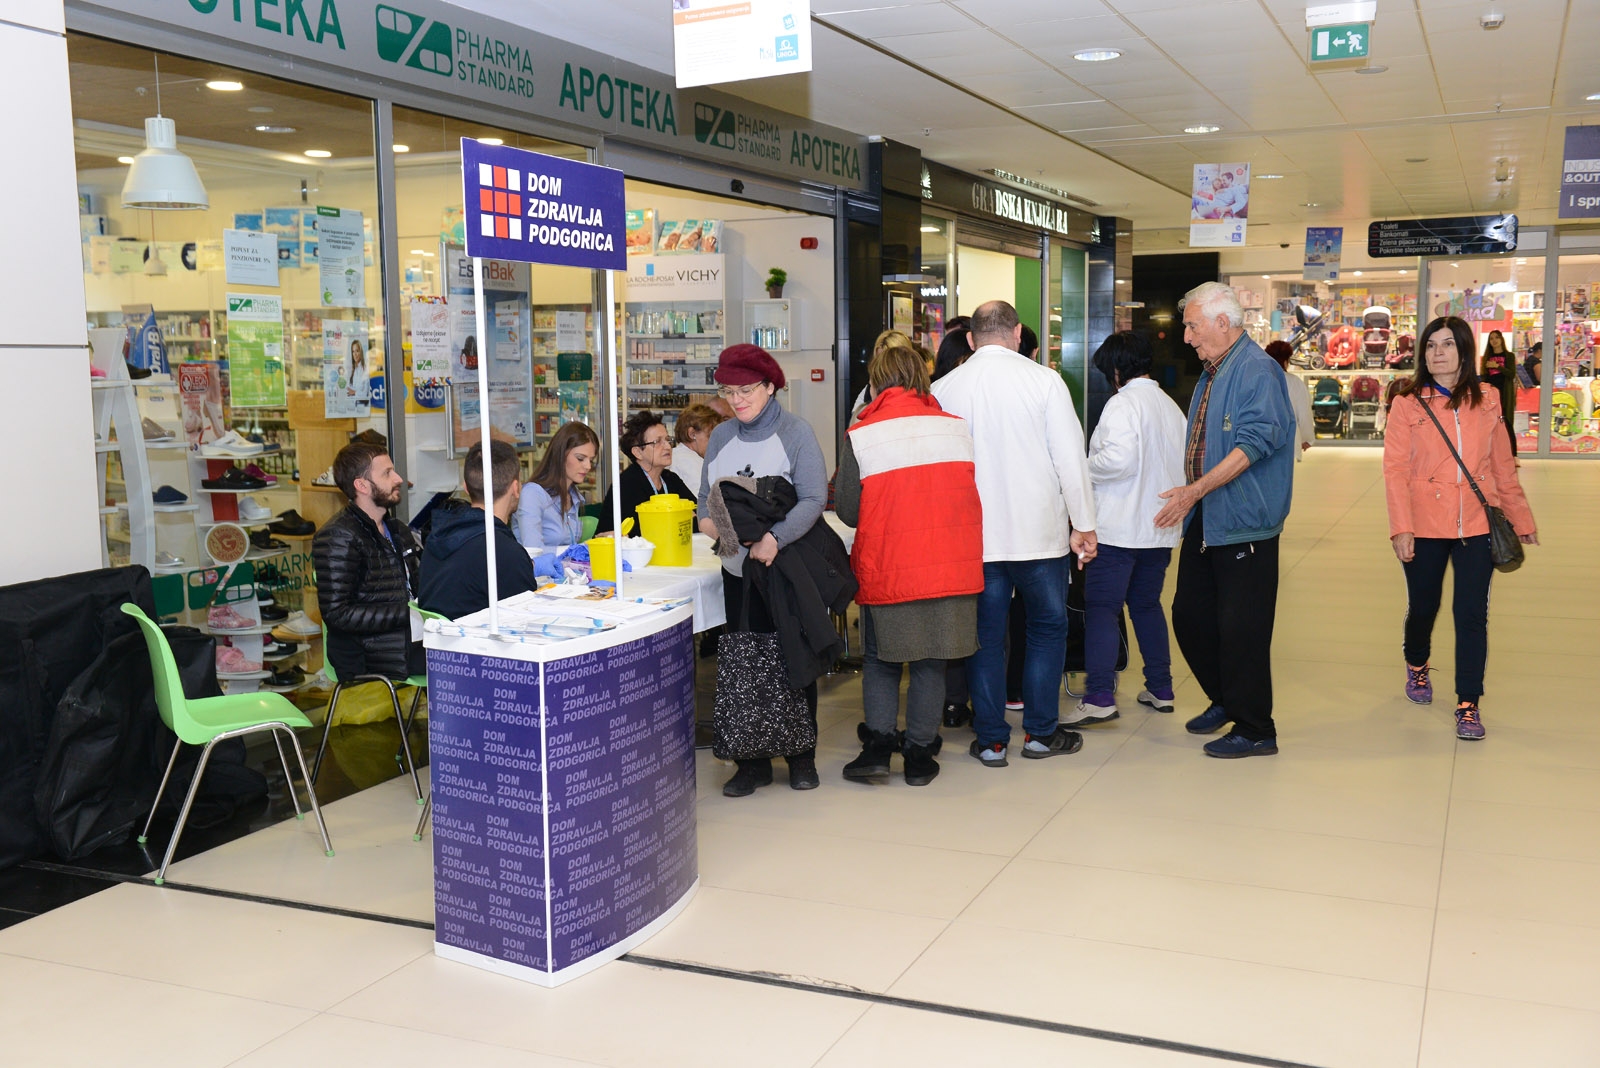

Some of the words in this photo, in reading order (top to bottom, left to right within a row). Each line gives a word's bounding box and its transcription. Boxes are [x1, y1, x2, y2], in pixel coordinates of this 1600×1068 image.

[456, 28, 534, 76] PHARMA
[458, 60, 534, 98] STANDARD
[559, 62, 678, 136] APOTEKA
[738, 114, 781, 144] PHARMA
[738, 138, 782, 162] STANDARD
[790, 130, 861, 181] APOTEKA
[528, 172, 562, 196] DOM
[528, 198, 603, 227] ZDRAVLJA
[971, 182, 1022, 223] GRADSKA
[1024, 198, 1068, 235] KNJIŽARA
[528, 224, 614, 252] PODGORICA
[1404, 246, 1430, 254] stepenice
[458, 258, 516, 281] EsnBak
[676, 269, 720, 282] VICHY
[148, 331, 161, 374] Oral-B
[607, 639, 645, 658] ZDRAVLJA
[608, 648, 650, 669] PODGORICA
[481, 656, 533, 672] ZDRAVLJA
[546, 652, 597, 672] ZDRAVLJA
[482, 670, 540, 686] PODGORICA
[546, 663, 604, 685] PODGORICA
[619, 669, 636, 683] DOM
[619, 674, 654, 695] ZDRAVLJA
[436, 679, 456, 691] DOM
[494, 688, 516, 700] DOM
[563, 685, 585, 698] DOM
[620, 683, 658, 707] PODGORICA
[436, 691, 484, 707] ZDRAVLJA
[563, 690, 610, 711] ZDRAVLJA
[436, 704, 492, 721] PODGORICA
[563, 700, 616, 724] PODGORICA
[609, 714, 627, 729] DOM
[483, 730, 506, 742] DOM
[548, 732, 573, 747] DOM
[609, 718, 646, 740] ZDRAVLJA
[483, 742, 536, 759] ZDRAVLJA
[548, 736, 600, 759] ZDRAVLJA
[610, 728, 651, 752] PODGORICA
[484, 754, 543, 772] PODGORICA
[549, 746, 606, 771] PODGORICA
[621, 750, 637, 764] DOM
[621, 752, 656, 776] ZDRAVLJA
[439, 762, 459, 774] DOM
[565, 769, 587, 785] DOM
[622, 762, 660, 788] PODGORICA
[439, 774, 487, 791] ZDRAVLJA
[497, 773, 520, 786] DOM
[565, 772, 612, 796] ZDRAVLJA
[440, 786, 495, 805] PODGORICA
[566, 782, 618, 808] PODGORICA
[612, 796, 629, 812] DOM
[612, 798, 648, 823] ZDRAVLJA
[486, 815, 509, 828] DOM
[551, 818, 576, 833] DOM
[612, 808, 653, 835] PODGORICA
[486, 827, 539, 846] ZDRAVLJA
[551, 820, 602, 845] ZDRAVLJA
[623, 830, 640, 846] DOM
[442, 844, 462, 857] DOM
[487, 839, 545, 859] PODGORICA
[552, 830, 609, 858] PODGORICA
[623, 832, 657, 858] ZDRAVLJA
[499, 858, 522, 871] DOM
[568, 853, 590, 870] DOM
[624, 841, 662, 869] PODGORICA
[442, 856, 490, 876] ZDRAVLJA
[568, 855, 614, 882] ZDRAVLJA
[442, 868, 497, 890] PODGORICA
[569, 864, 621, 894] PODGORICA
[614, 872, 631, 889] DOM
[614, 873, 650, 900] ZDRAVLJA
[489, 894, 511, 907] DOM
[554, 897, 578, 913] DOM
[614, 881, 655, 912] PODGORICA
[489, 906, 541, 927] ZDRAVLJA
[554, 898, 604, 926] ZDRAVLJA
[554, 907, 610, 938] PODGORICA
[626, 905, 642, 922] DOM
[626, 905, 660, 933] ZDRAVLJA
[444, 921, 464, 934] DOM
[444, 933, 493, 953] ZDRAVLJA
[502, 937, 525, 951] DOM
[570, 932, 592, 949] DOM
[570, 931, 617, 961] ZDRAVLJA
